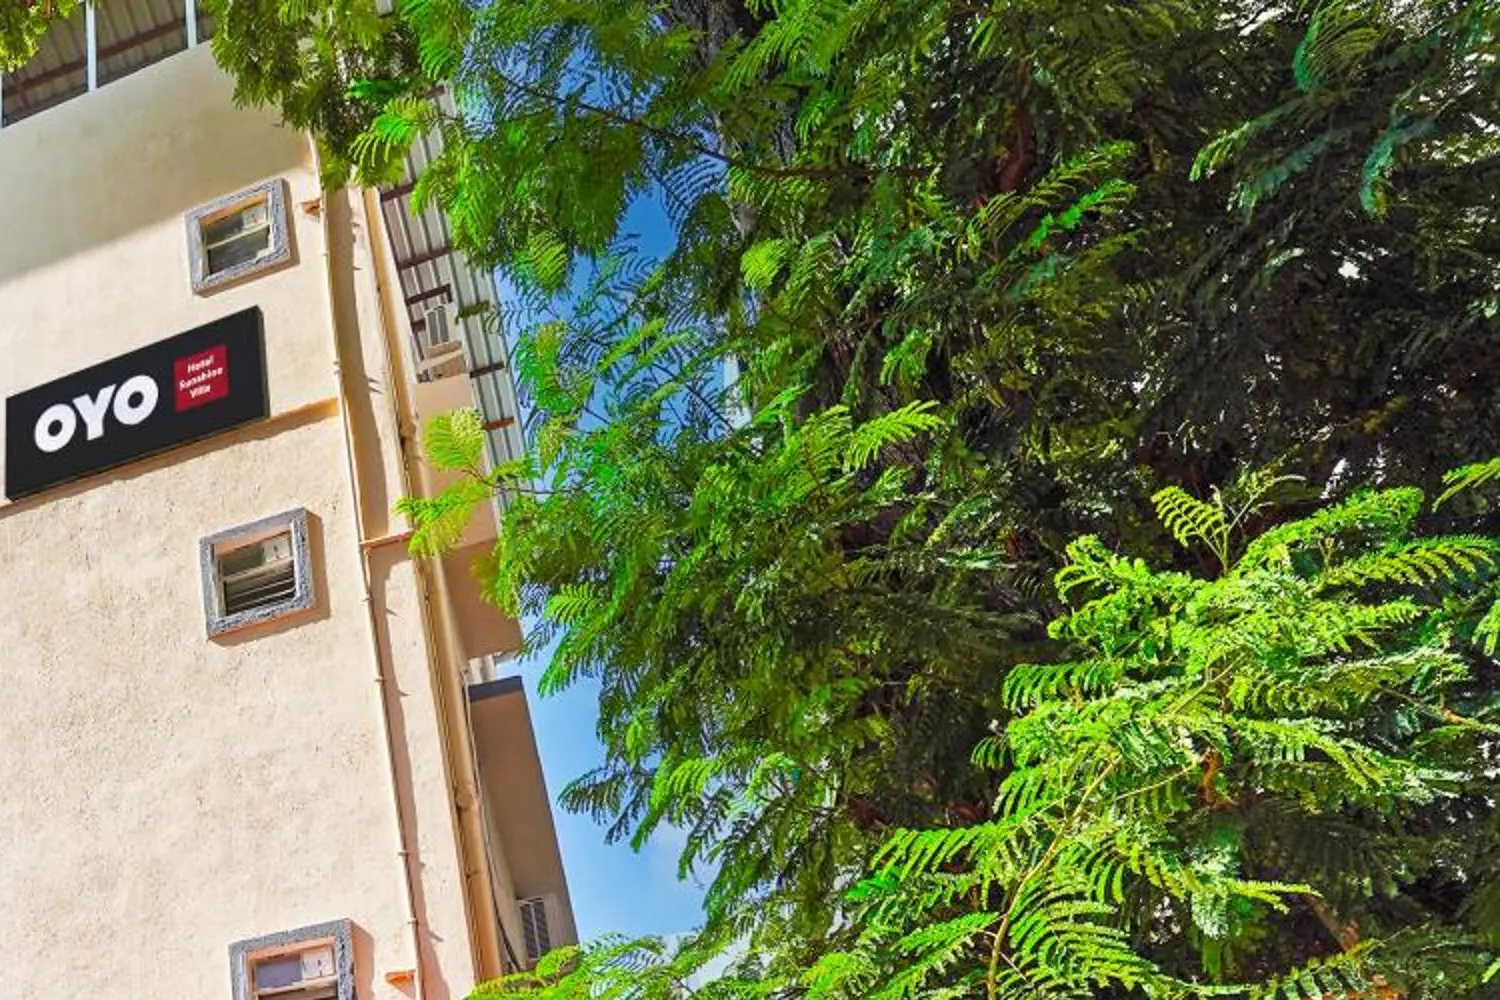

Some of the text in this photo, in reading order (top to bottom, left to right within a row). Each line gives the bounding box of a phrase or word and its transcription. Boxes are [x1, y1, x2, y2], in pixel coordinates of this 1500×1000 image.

[187, 355, 214, 373] Hotel
[179, 367, 223, 391] Sunshine
[34, 375, 159, 453] OYO
